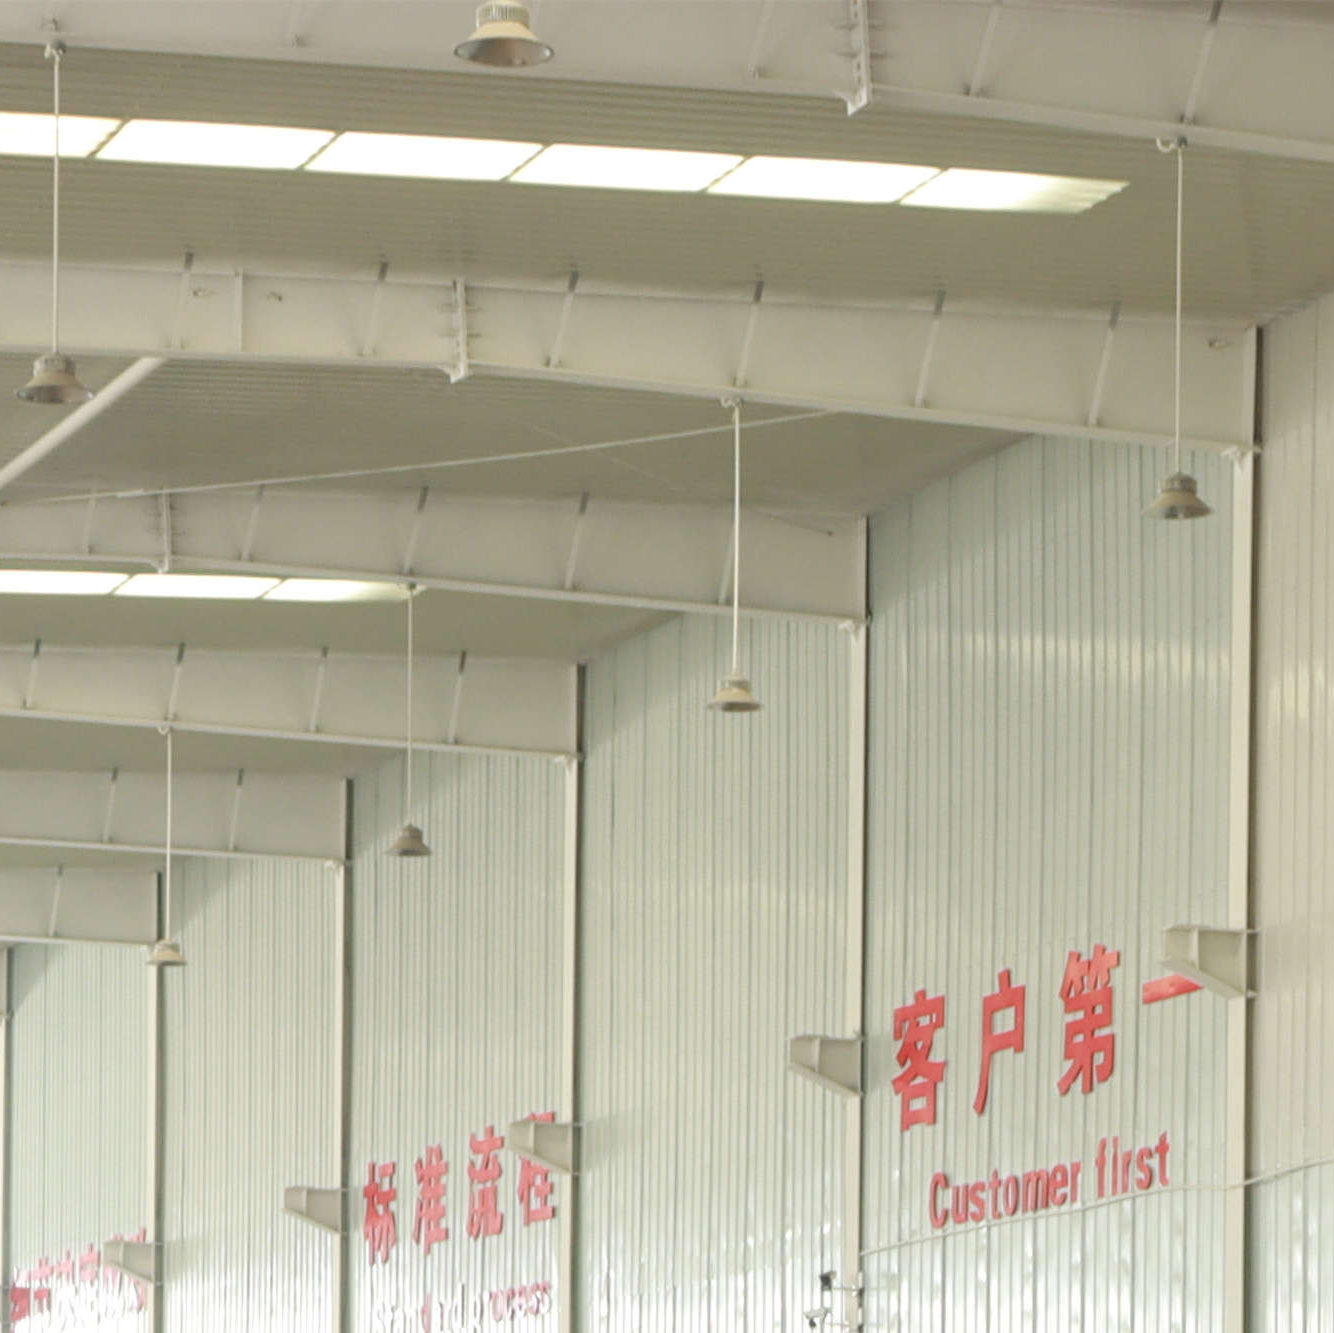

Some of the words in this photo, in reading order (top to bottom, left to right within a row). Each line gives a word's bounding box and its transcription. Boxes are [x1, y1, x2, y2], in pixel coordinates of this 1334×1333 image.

[891, 944, 1204, 1133] 客户第一
[929, 1160, 1082, 1230] Customer
[1095, 1132, 1171, 1199] first
